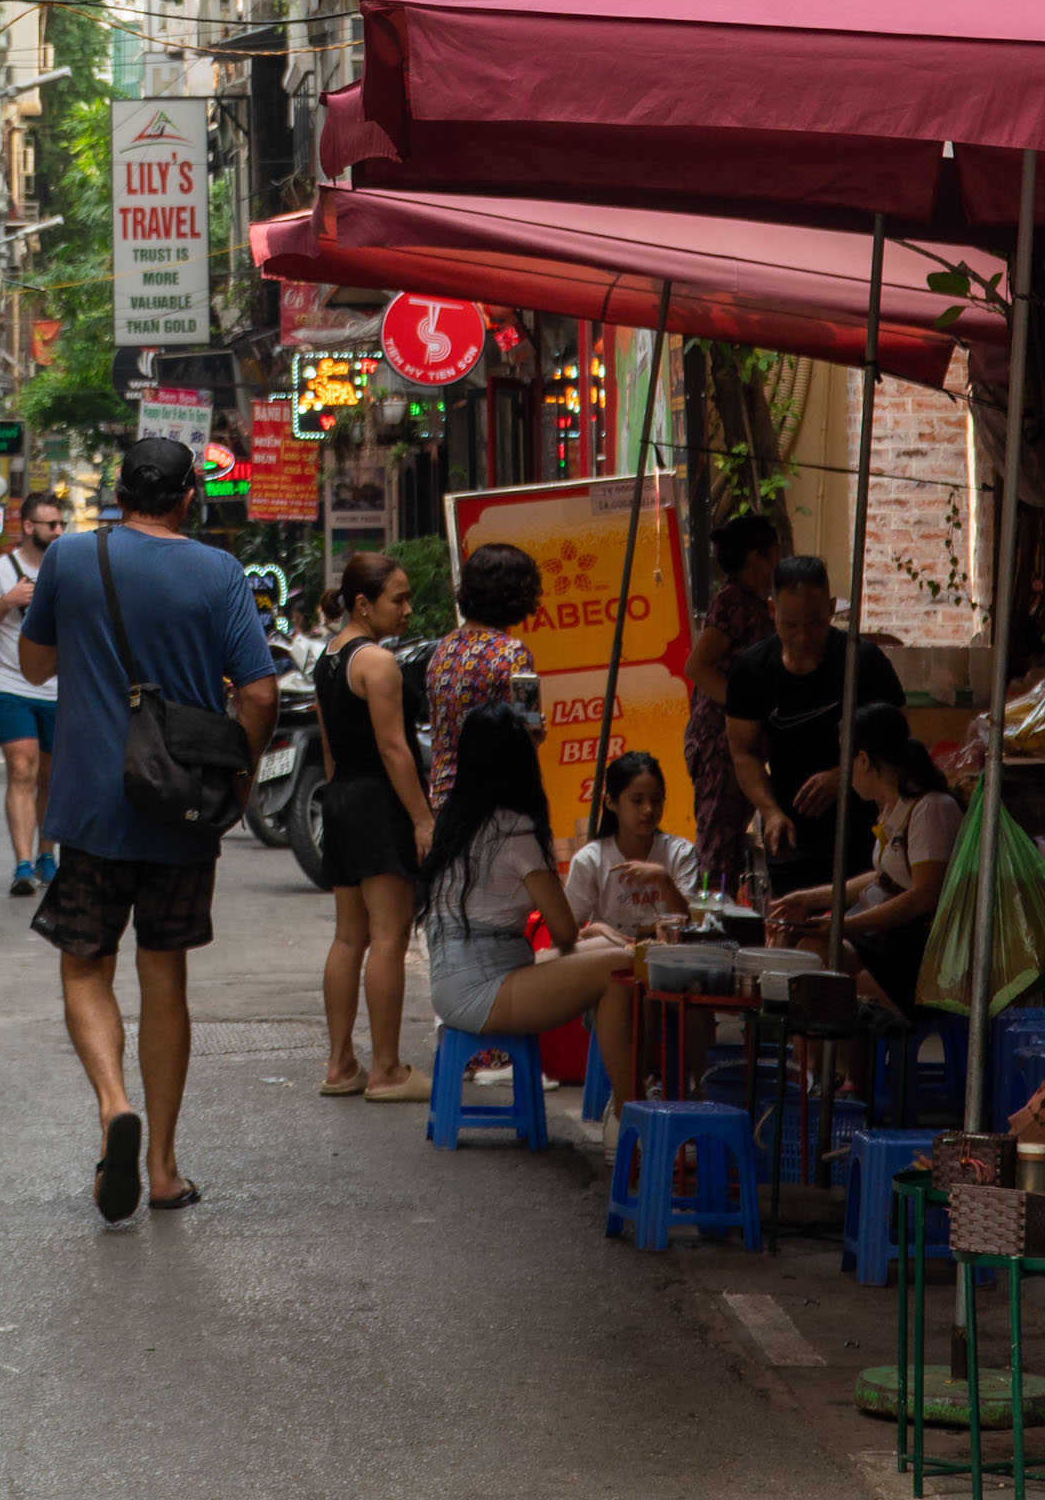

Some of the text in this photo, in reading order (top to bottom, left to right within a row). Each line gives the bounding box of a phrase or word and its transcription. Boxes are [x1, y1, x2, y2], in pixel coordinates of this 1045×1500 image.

[126, 151, 194, 195] LILY'S
[119, 205, 202, 241] TRAVEL
[132, 247, 190, 263] TRUST IS
[143, 272, 180, 286] MORE
[130, 294, 192, 311] VALUABLE
[127, 319, 197, 334] THAN GOLD
